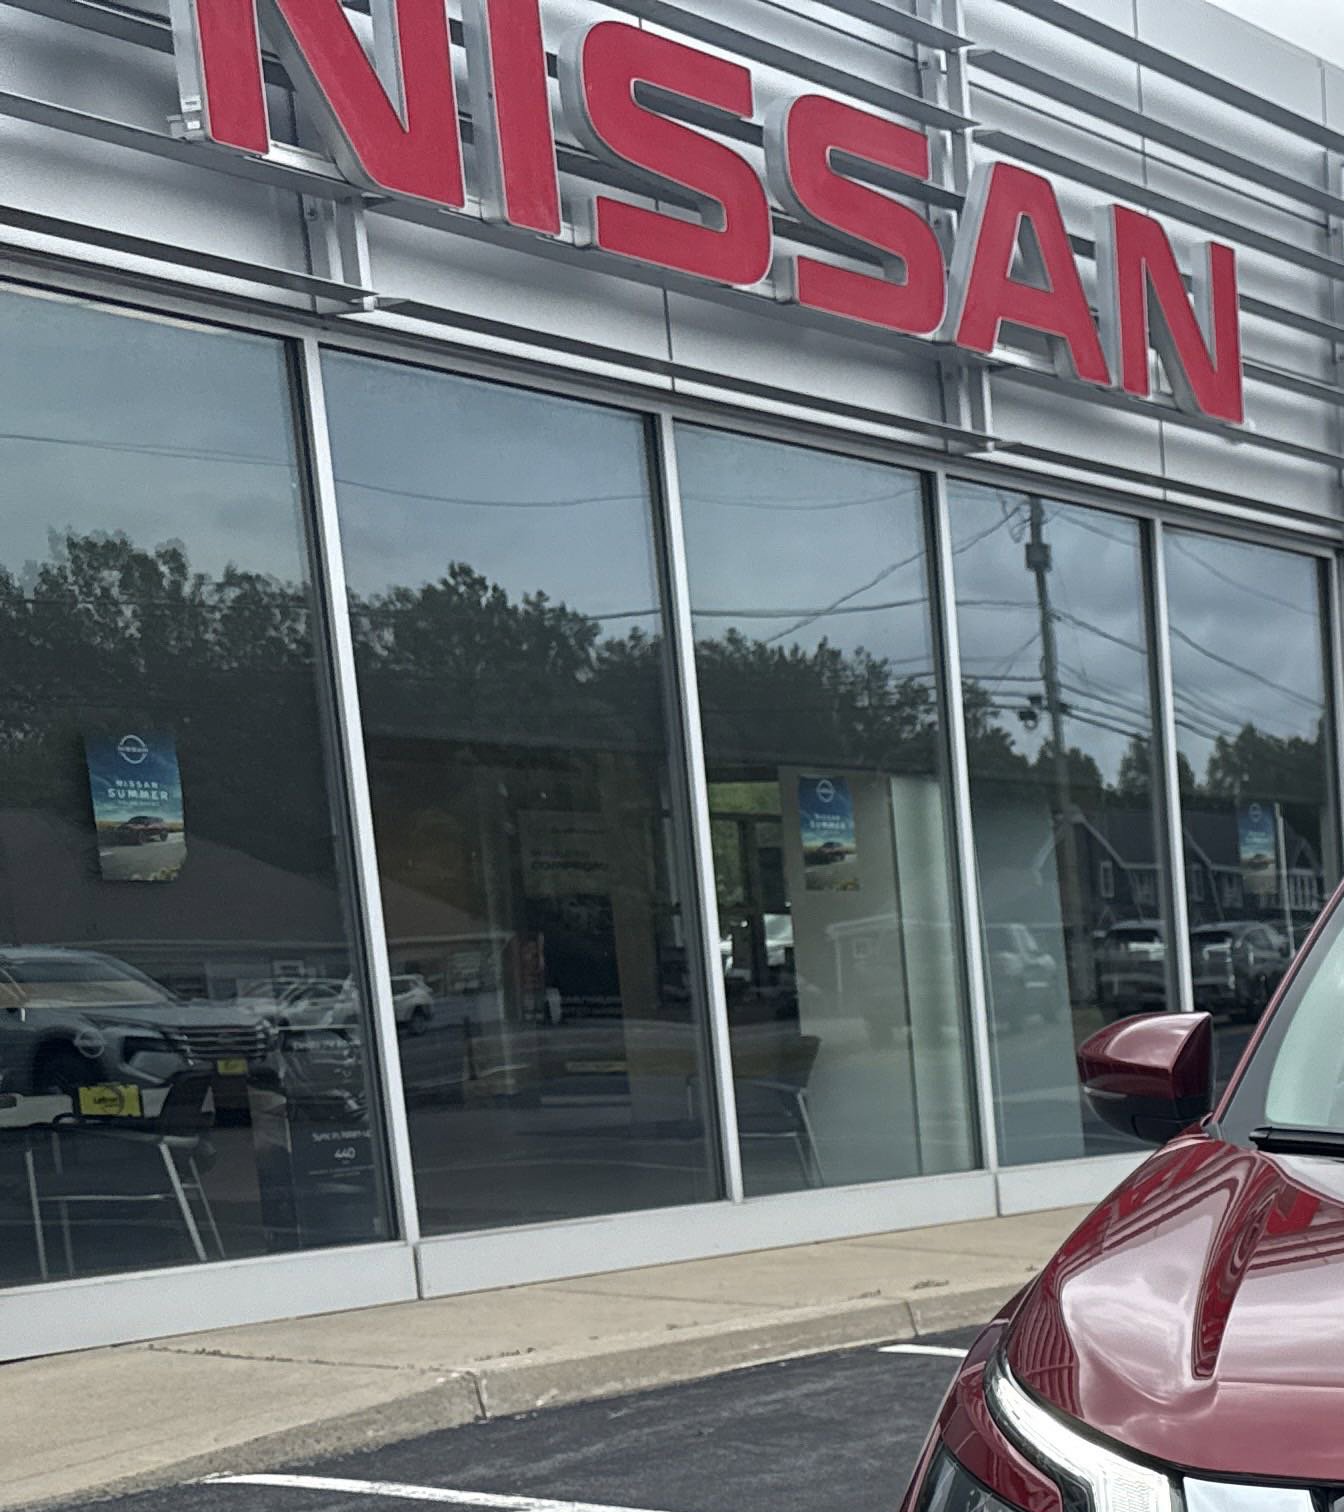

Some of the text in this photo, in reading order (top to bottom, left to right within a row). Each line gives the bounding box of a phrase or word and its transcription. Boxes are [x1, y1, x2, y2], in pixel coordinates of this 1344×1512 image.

[180, 0, 1245, 425] NISSAN
[115, 780, 158, 789] NISSAN
[107, 788, 169, 801] SUMMER
